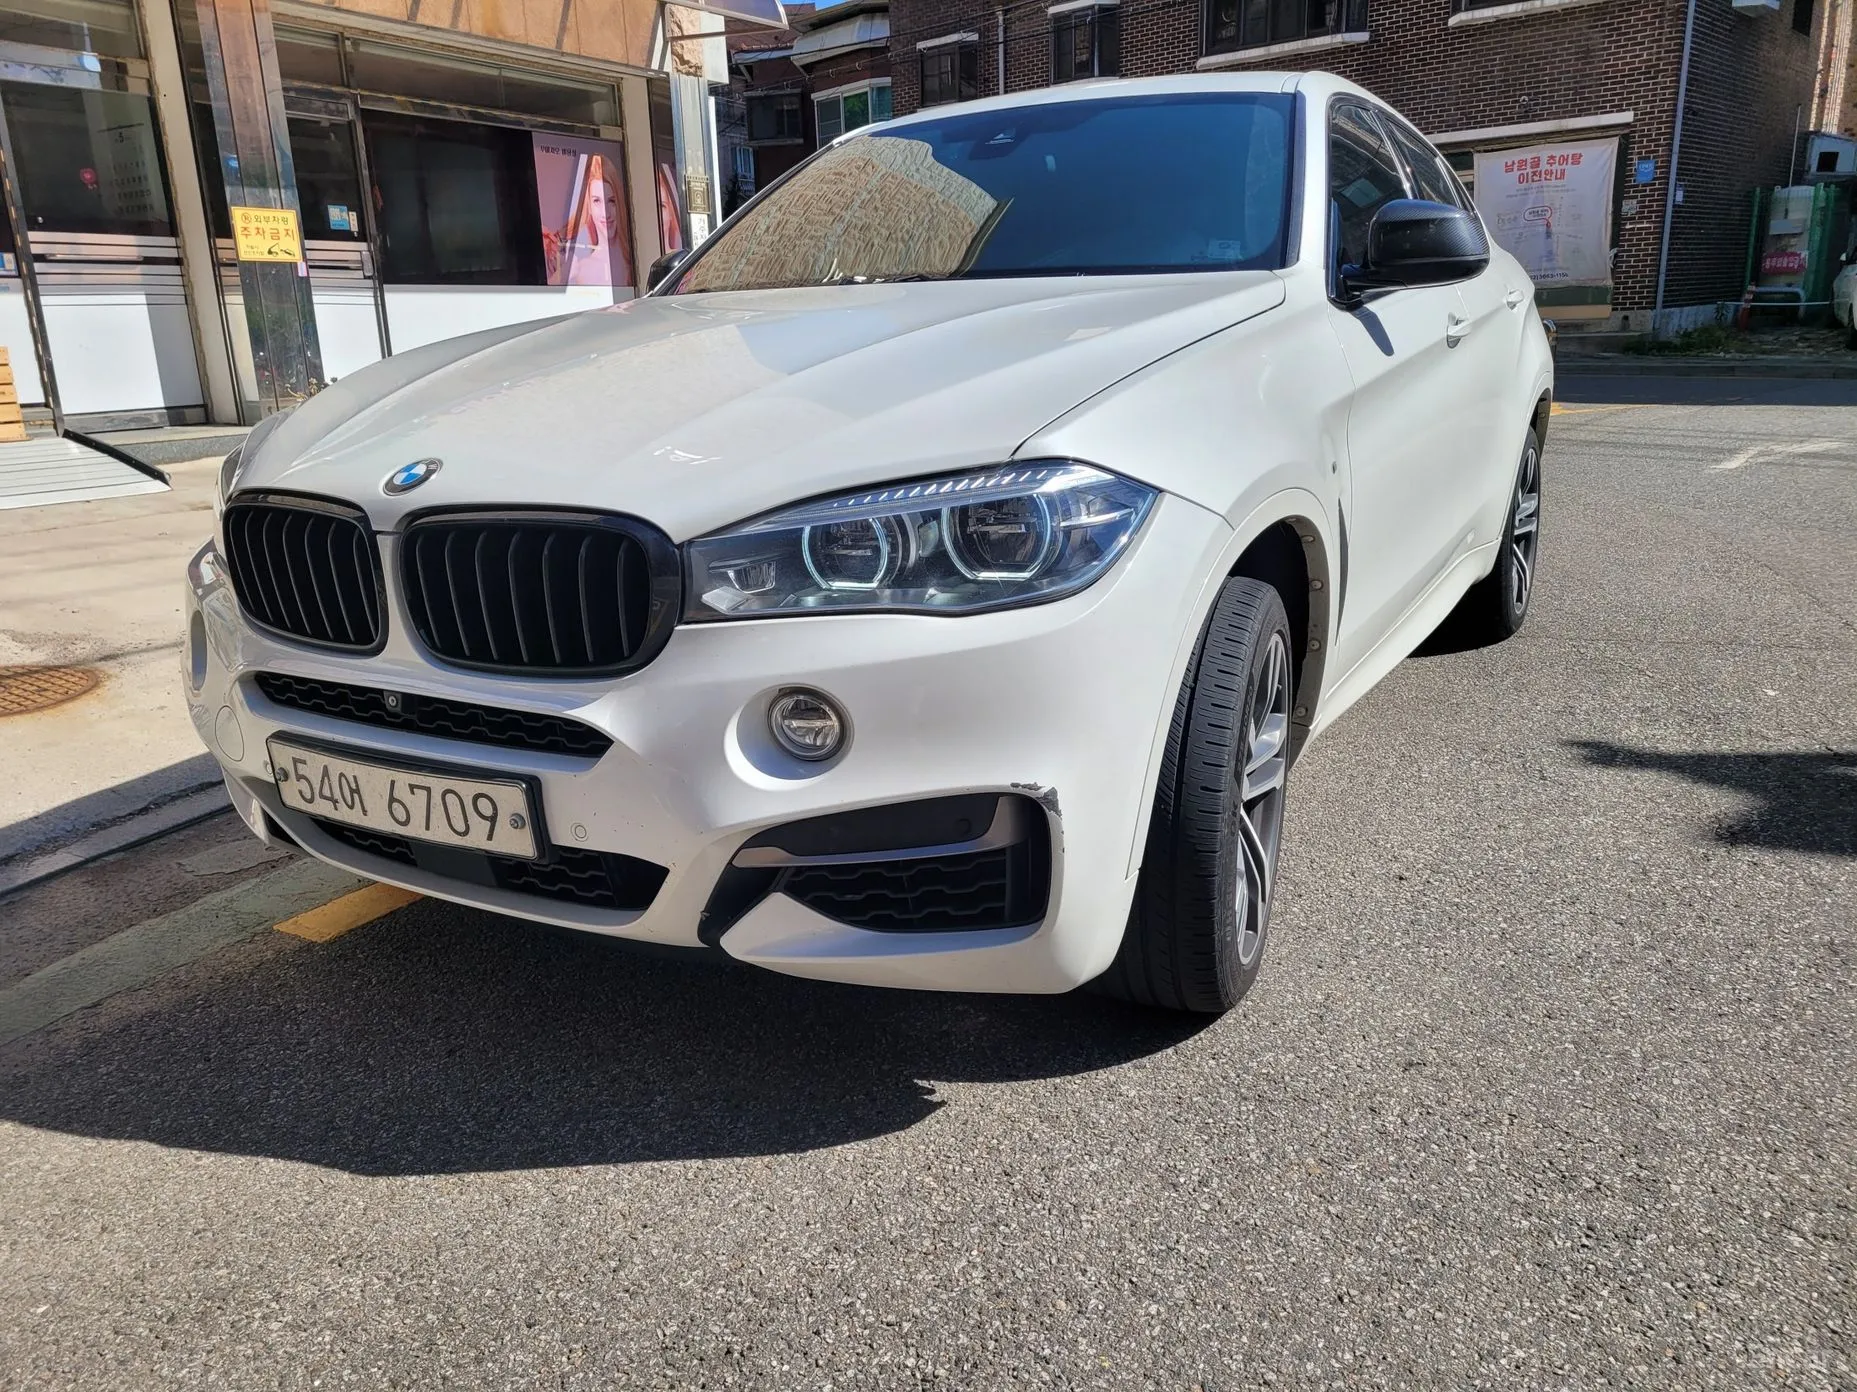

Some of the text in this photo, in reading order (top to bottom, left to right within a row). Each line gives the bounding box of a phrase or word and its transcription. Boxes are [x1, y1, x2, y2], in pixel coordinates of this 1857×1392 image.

[1504, 152, 1583, 173] 남원골 추어탕
[1518, 169, 1566, 184] 이전안내
[254, 214, 288, 226] 외부차량
[240, 226, 295, 241] 주차금지
[291, 756, 499, 841] 54어 6709
